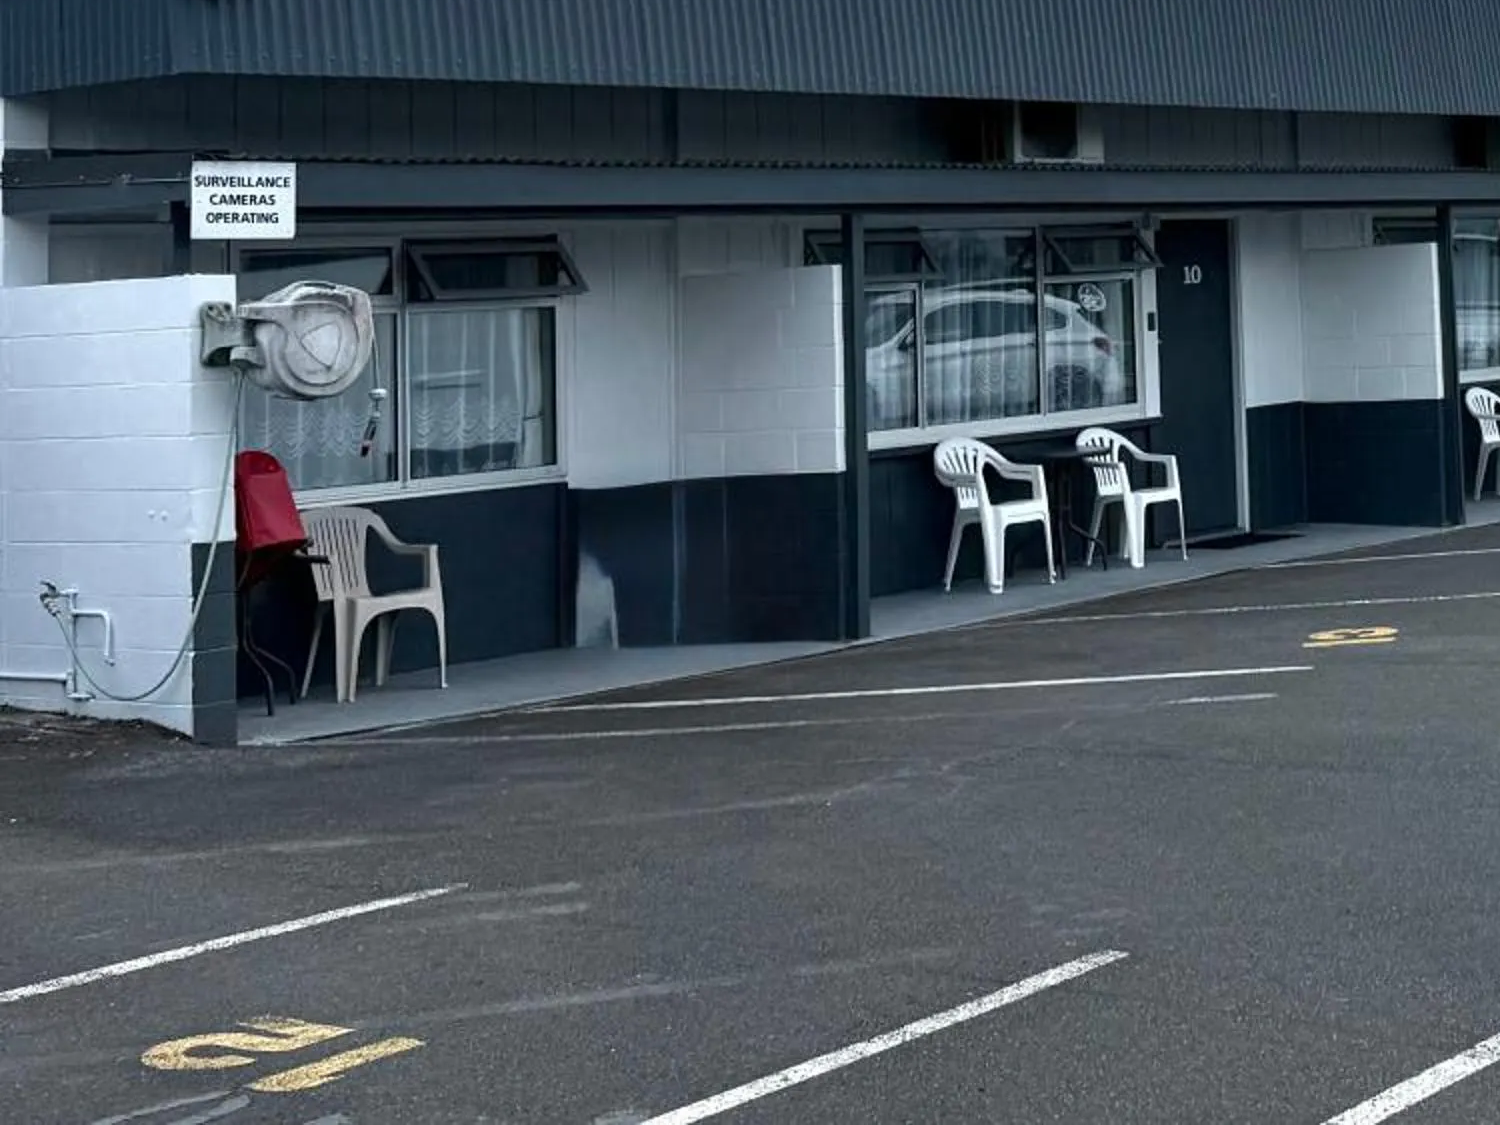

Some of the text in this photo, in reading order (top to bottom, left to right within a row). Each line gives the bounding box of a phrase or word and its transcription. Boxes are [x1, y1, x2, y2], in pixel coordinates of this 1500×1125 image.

[194, 176, 291, 187] SURVEILLANCE
[209, 194, 276, 206] CAMERAS
[205, 212, 280, 224] OPERATING
[1183, 265, 1202, 285] 10
